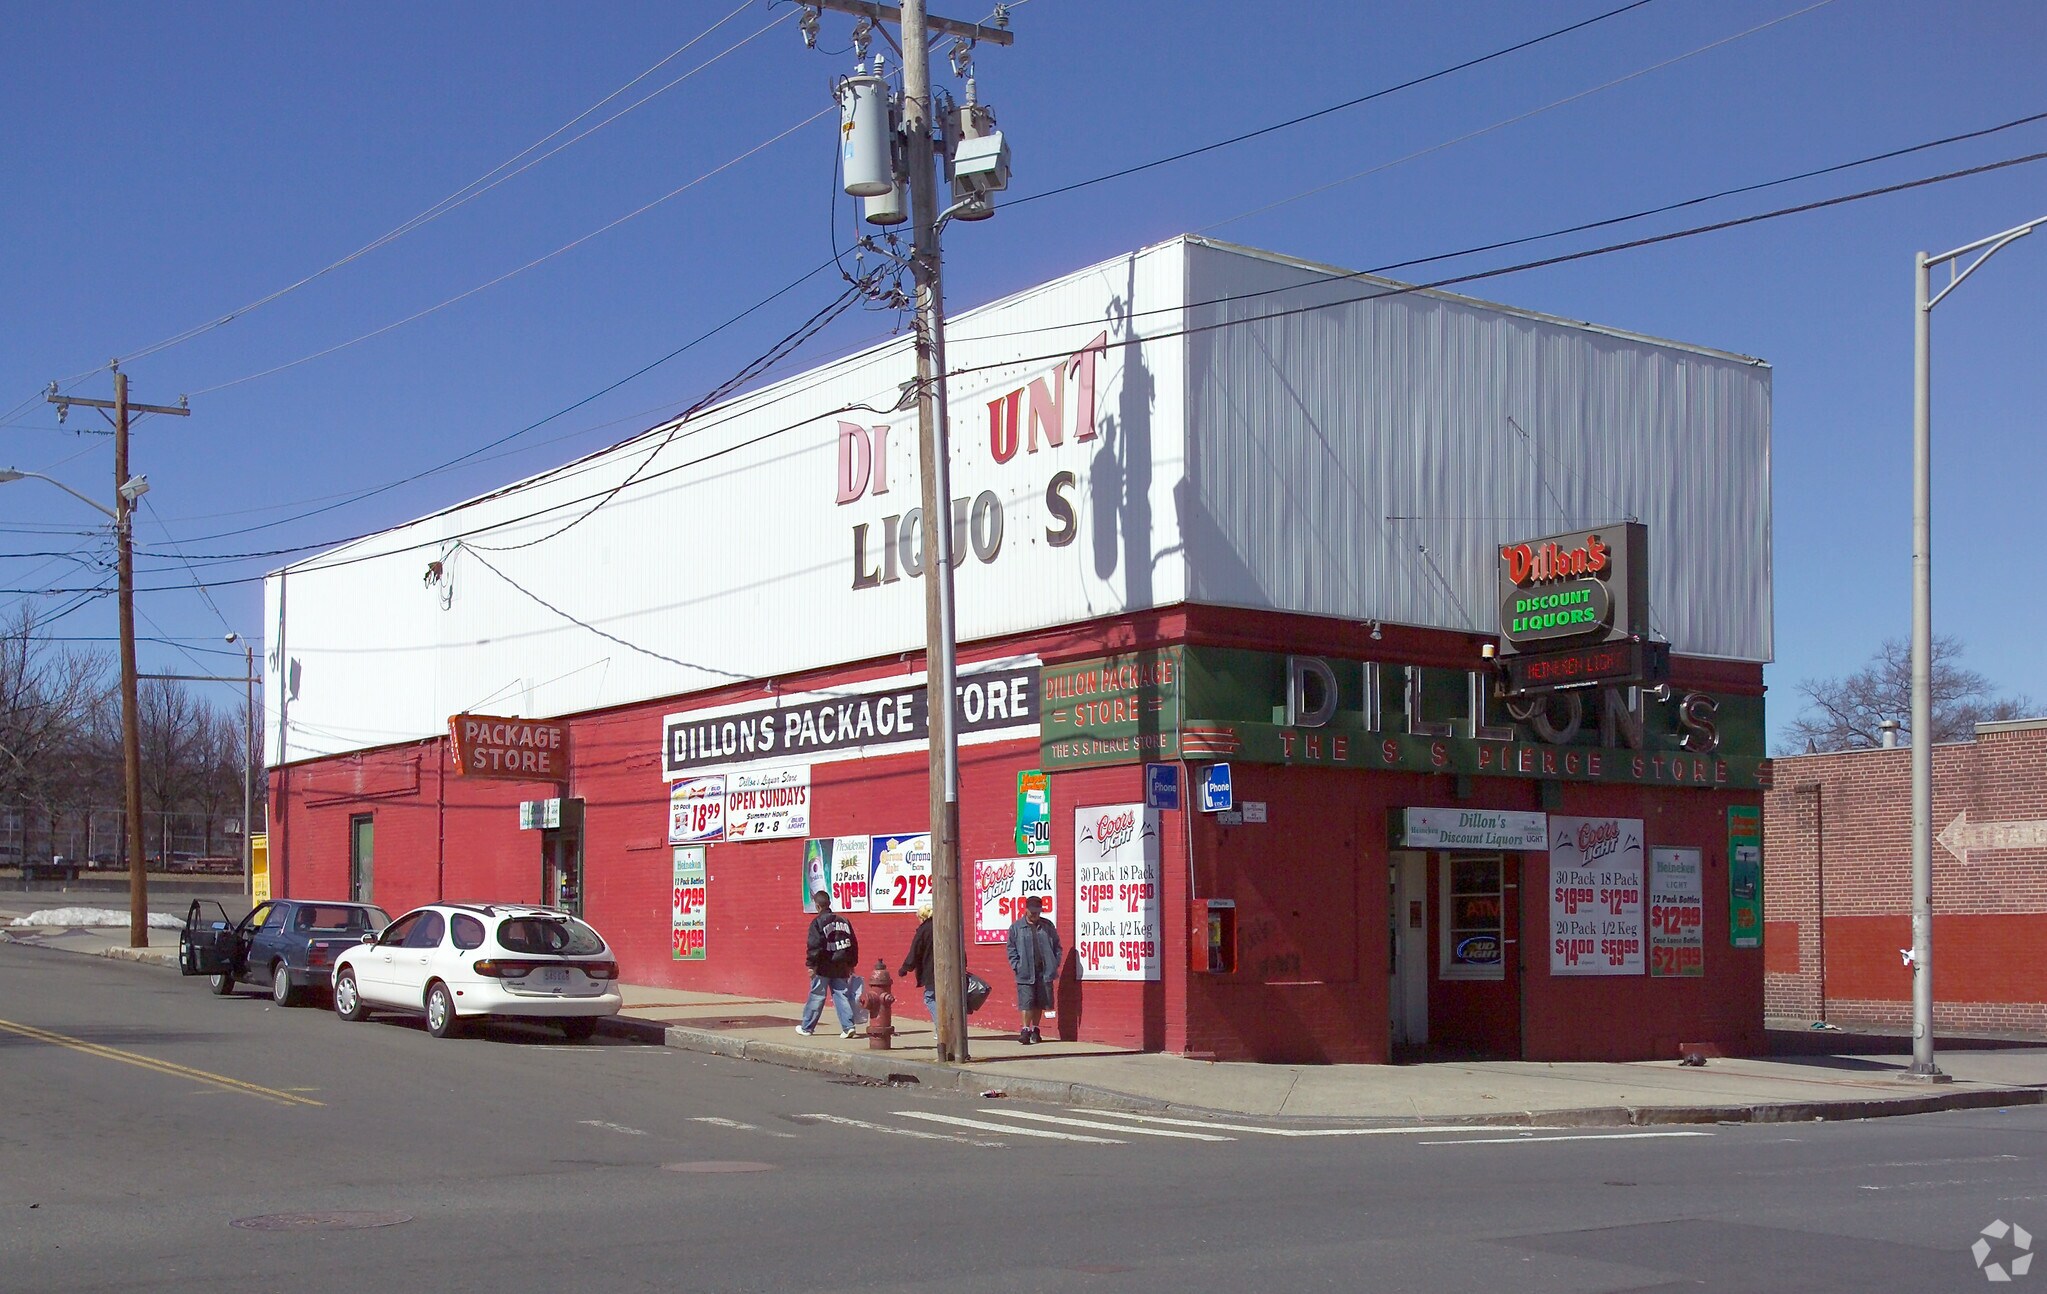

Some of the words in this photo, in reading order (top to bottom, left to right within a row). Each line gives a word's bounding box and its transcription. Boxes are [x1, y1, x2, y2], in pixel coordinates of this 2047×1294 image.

[1502, 535, 1606, 585] Dillon's
[1516, 589, 1591, 614] DISCOUNT
[1512, 607, 1595, 633] LIQUORS
[1045, 670, 1097, 700] DILLON
[1100, 659, 1173, 693] PACKAGE
[1074, 696, 1139, 727] STORE
[465, 721, 561, 750] PACKAGE
[674, 715, 775, 763] DILLONS
[784, 693, 914, 748] PACKAGE
[1051, 744, 1069, 759] THE
[1092, 736, 1129, 755] PIERCE
[1133, 733, 1167, 750] STORE
[1278, 732, 1349, 761] THE
[1478, 746, 1601, 776] PIERCE
[1632, 755, 1727, 783] STORE
[473, 748, 550, 773] STORE
[738, 776, 760, 788] Dillon's
[781, 771, 798, 783] Store
[1154, 781, 1177, 793] Phone
[1209, 782, 1230, 793] Phone
[729, 790, 756, 811] OPEN
[759, 785, 806, 810] SUNDAYS
[691, 803, 721, 832] 1899
[746, 811, 771, 820] Summer
[771, 810, 789, 818] Hours
[754, 821, 765, 833] 12
[772, 820, 780, 832] 8
[1096, 809, 1135, 843] Coors
[1458, 812, 1507, 829] Dillon's
[1100, 826, 1134, 858] LIGHT
[1411, 826, 1439, 835] Heineken
[1439, 830, 1483, 844] Discount
[1485, 831, 1523, 847] Liquors
[1526, 835, 1544, 843] LIGHT
[1578, 820, 1620, 850] Coors
[905, 850, 931, 865] Corona
[1581, 838, 1618, 867] LIGHT
[843, 871, 865, 881] Packs
[981, 859, 1016, 892] Coors
[1028, 861, 1043, 878] 30
[1080, 867, 1091, 882] 30
[1092, 865, 1115, 882] Pack
[1119, 866, 1129, 881] 18
[1131, 865, 1154, 881] Pack
[1556, 870, 1568, 885] 30
[1570, 870, 1596, 886] Pack
[1600, 872, 1611, 886] 18
[1613, 872, 1639, 886] Pack
[1656, 861, 1696, 874] Heineken
[983, 876, 1014, 905] LIGHT
[1021, 873, 1052, 896] pack
[1119, 882, 1155, 913] $1290
[1665, 881, 1688, 889] LIGHT
[674, 887, 705, 914] $1299
[999, 895, 1053, 923] $189
[1080, 883, 1114, 914] $1999
[1555, 887, 1594, 915] $1999
[1600, 888, 1639, 915] $1290
[1652, 895, 1660, 903] 12
[1661, 895, 1678, 904] Pack
[1679, 895, 1700, 904] Bottles
[1080, 921, 1091, 937] 20
[1092, 920, 1116, 936] Pack
[1119, 920, 1131, 938] 1/2
[1133, 920, 1153, 938] Keg
[1556, 921, 1569, 935] 20
[1570, 920, 1597, 935] Pack
[1601, 921, 1616, 937] 1/2
[1618, 921, 1638, 938] Keg
[1651, 904, 1701, 935] $1299
[673, 928, 705, 956] $2199
[1463, 950, 1499, 959] LIGHT
[1555, 938, 1594, 966] $1400
[1601, 938, 1639, 966] $5999
[1080, 940, 1114, 971] $1400
[1119, 940, 1155, 972] $5999
[1652, 945, 1701, 974] $2199
